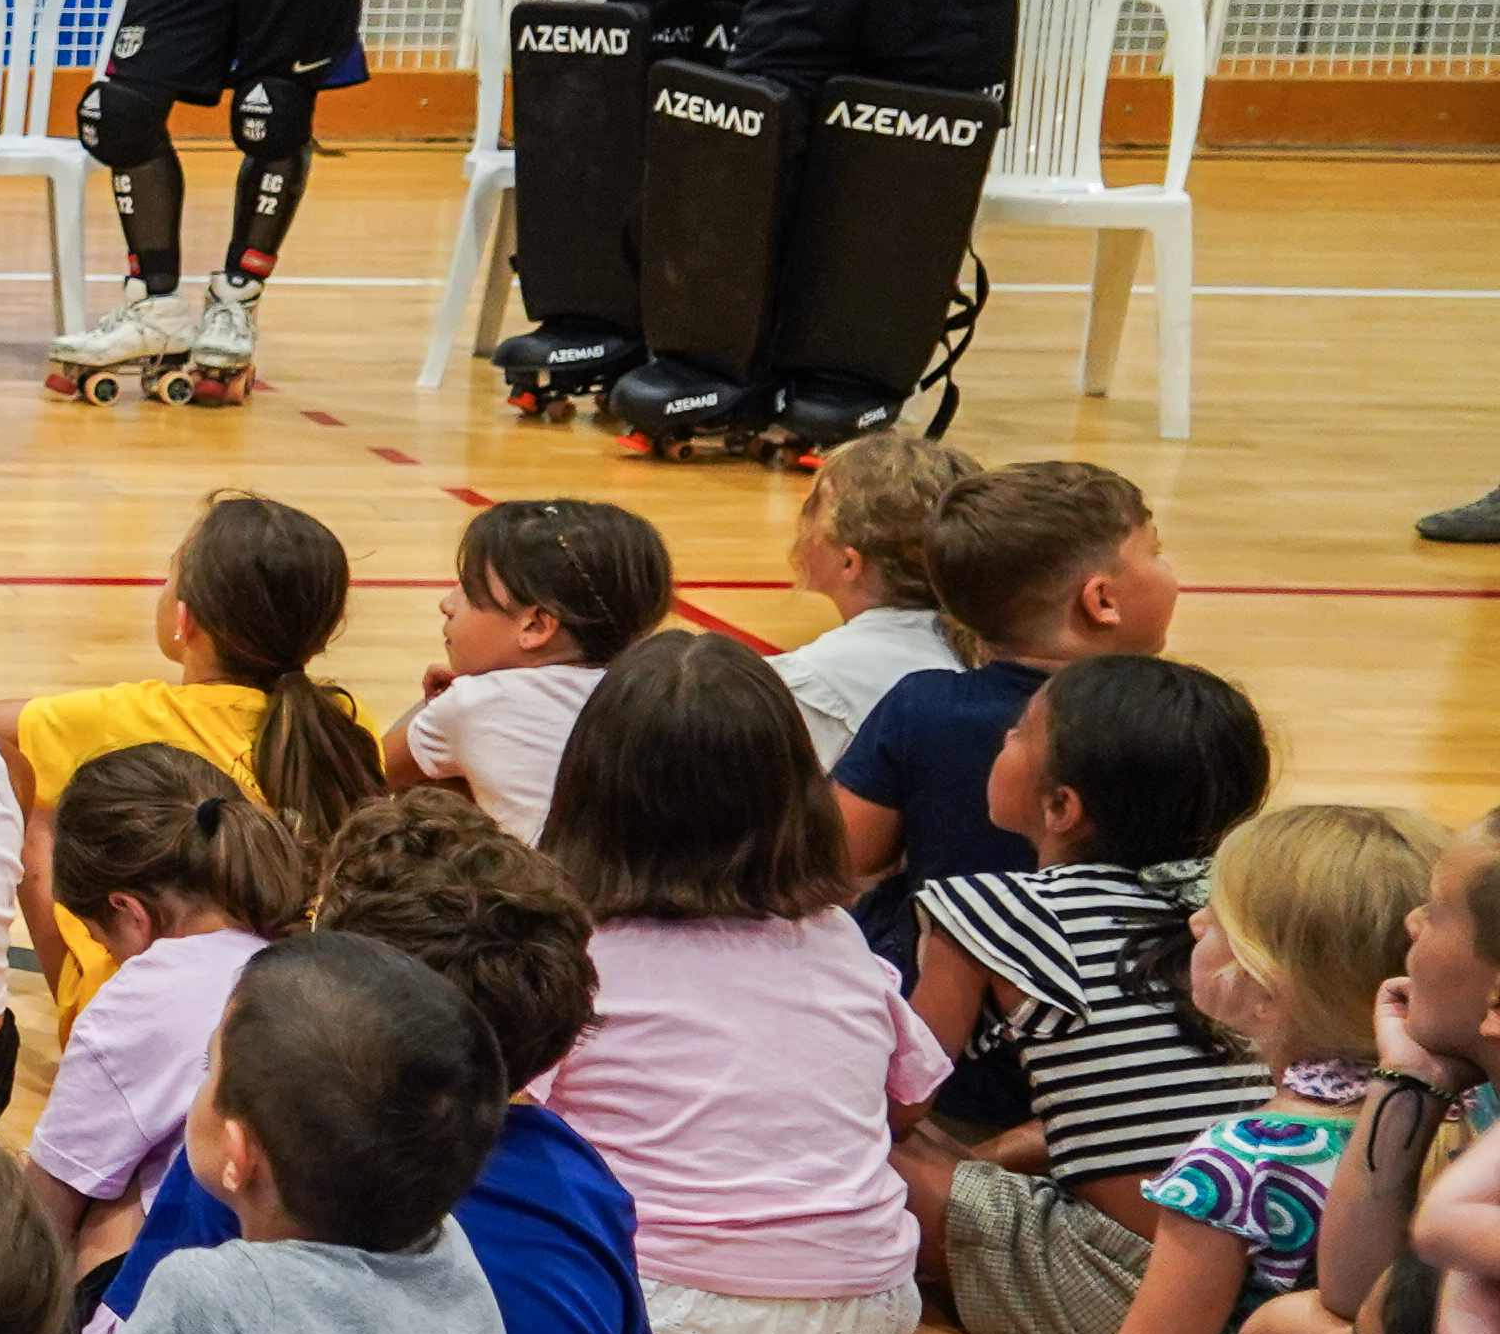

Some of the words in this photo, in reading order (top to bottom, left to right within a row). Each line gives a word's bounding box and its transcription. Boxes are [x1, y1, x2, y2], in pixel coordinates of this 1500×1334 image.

[517, 24, 629, 56] AZEMAD
[653, 88, 762, 137] AZEMAD
[824, 100, 978, 147] AZEMAD
